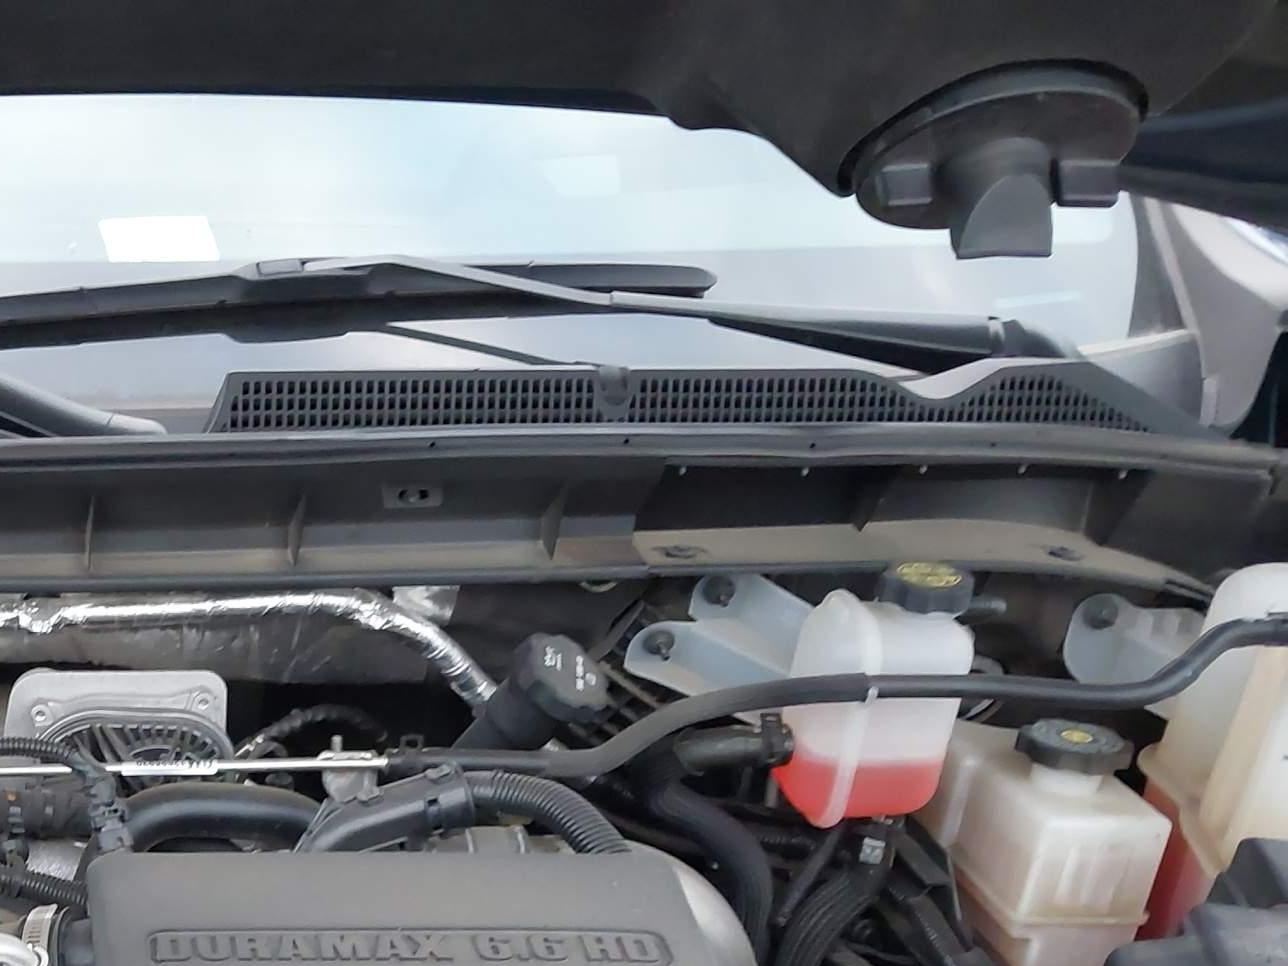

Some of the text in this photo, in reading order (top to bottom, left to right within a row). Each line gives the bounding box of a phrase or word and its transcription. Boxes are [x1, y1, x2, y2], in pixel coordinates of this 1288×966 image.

[151, 933, 661, 963] DURAMAX 6.6 HD
